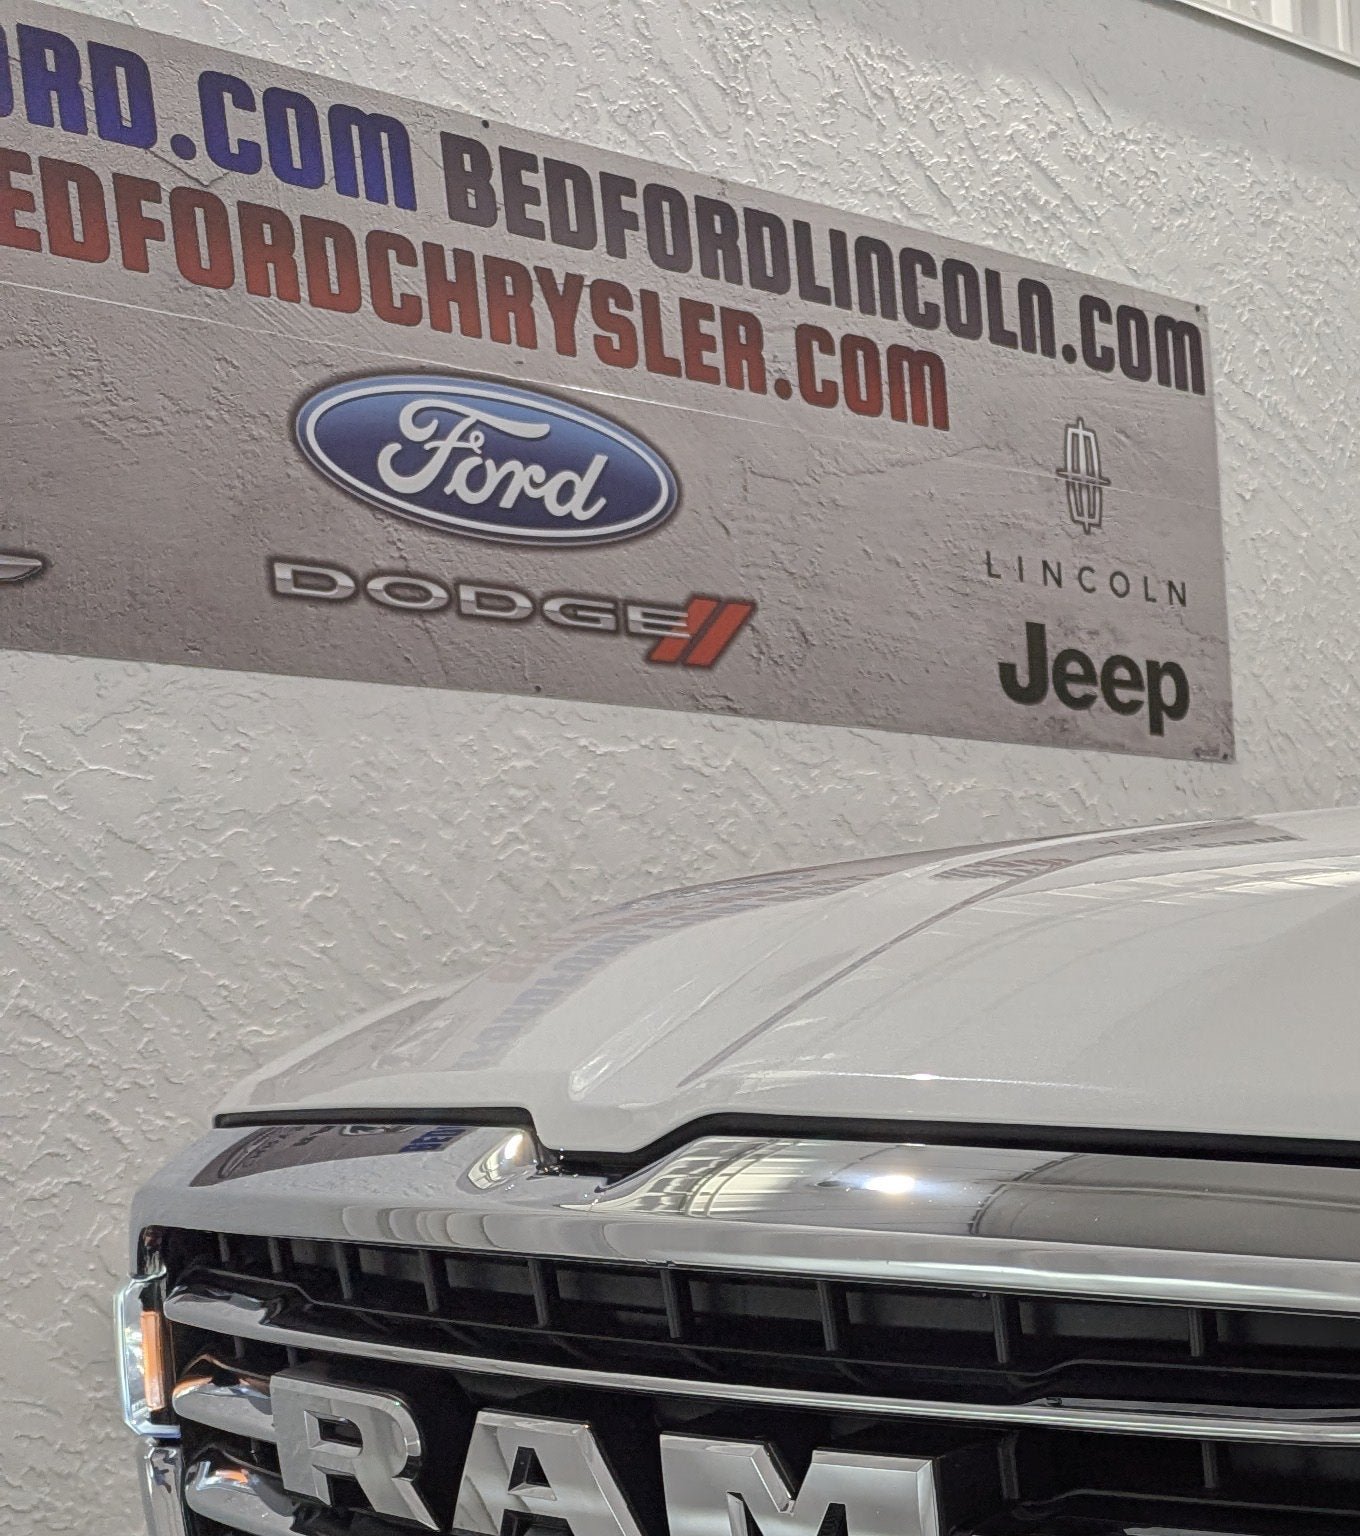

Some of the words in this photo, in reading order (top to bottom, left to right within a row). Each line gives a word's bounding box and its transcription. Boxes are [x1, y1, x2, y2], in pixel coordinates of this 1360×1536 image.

[0, 22, 417, 211] RD.COM
[440, 130, 1206, 396] BEDFORDLINCOLN.COM
[377, 399, 609, 521] Ford
[273, 561, 691, 640] DODGE
[985, 550, 1189, 608] LINCOLN
[997, 621, 1191, 738] Jeep
